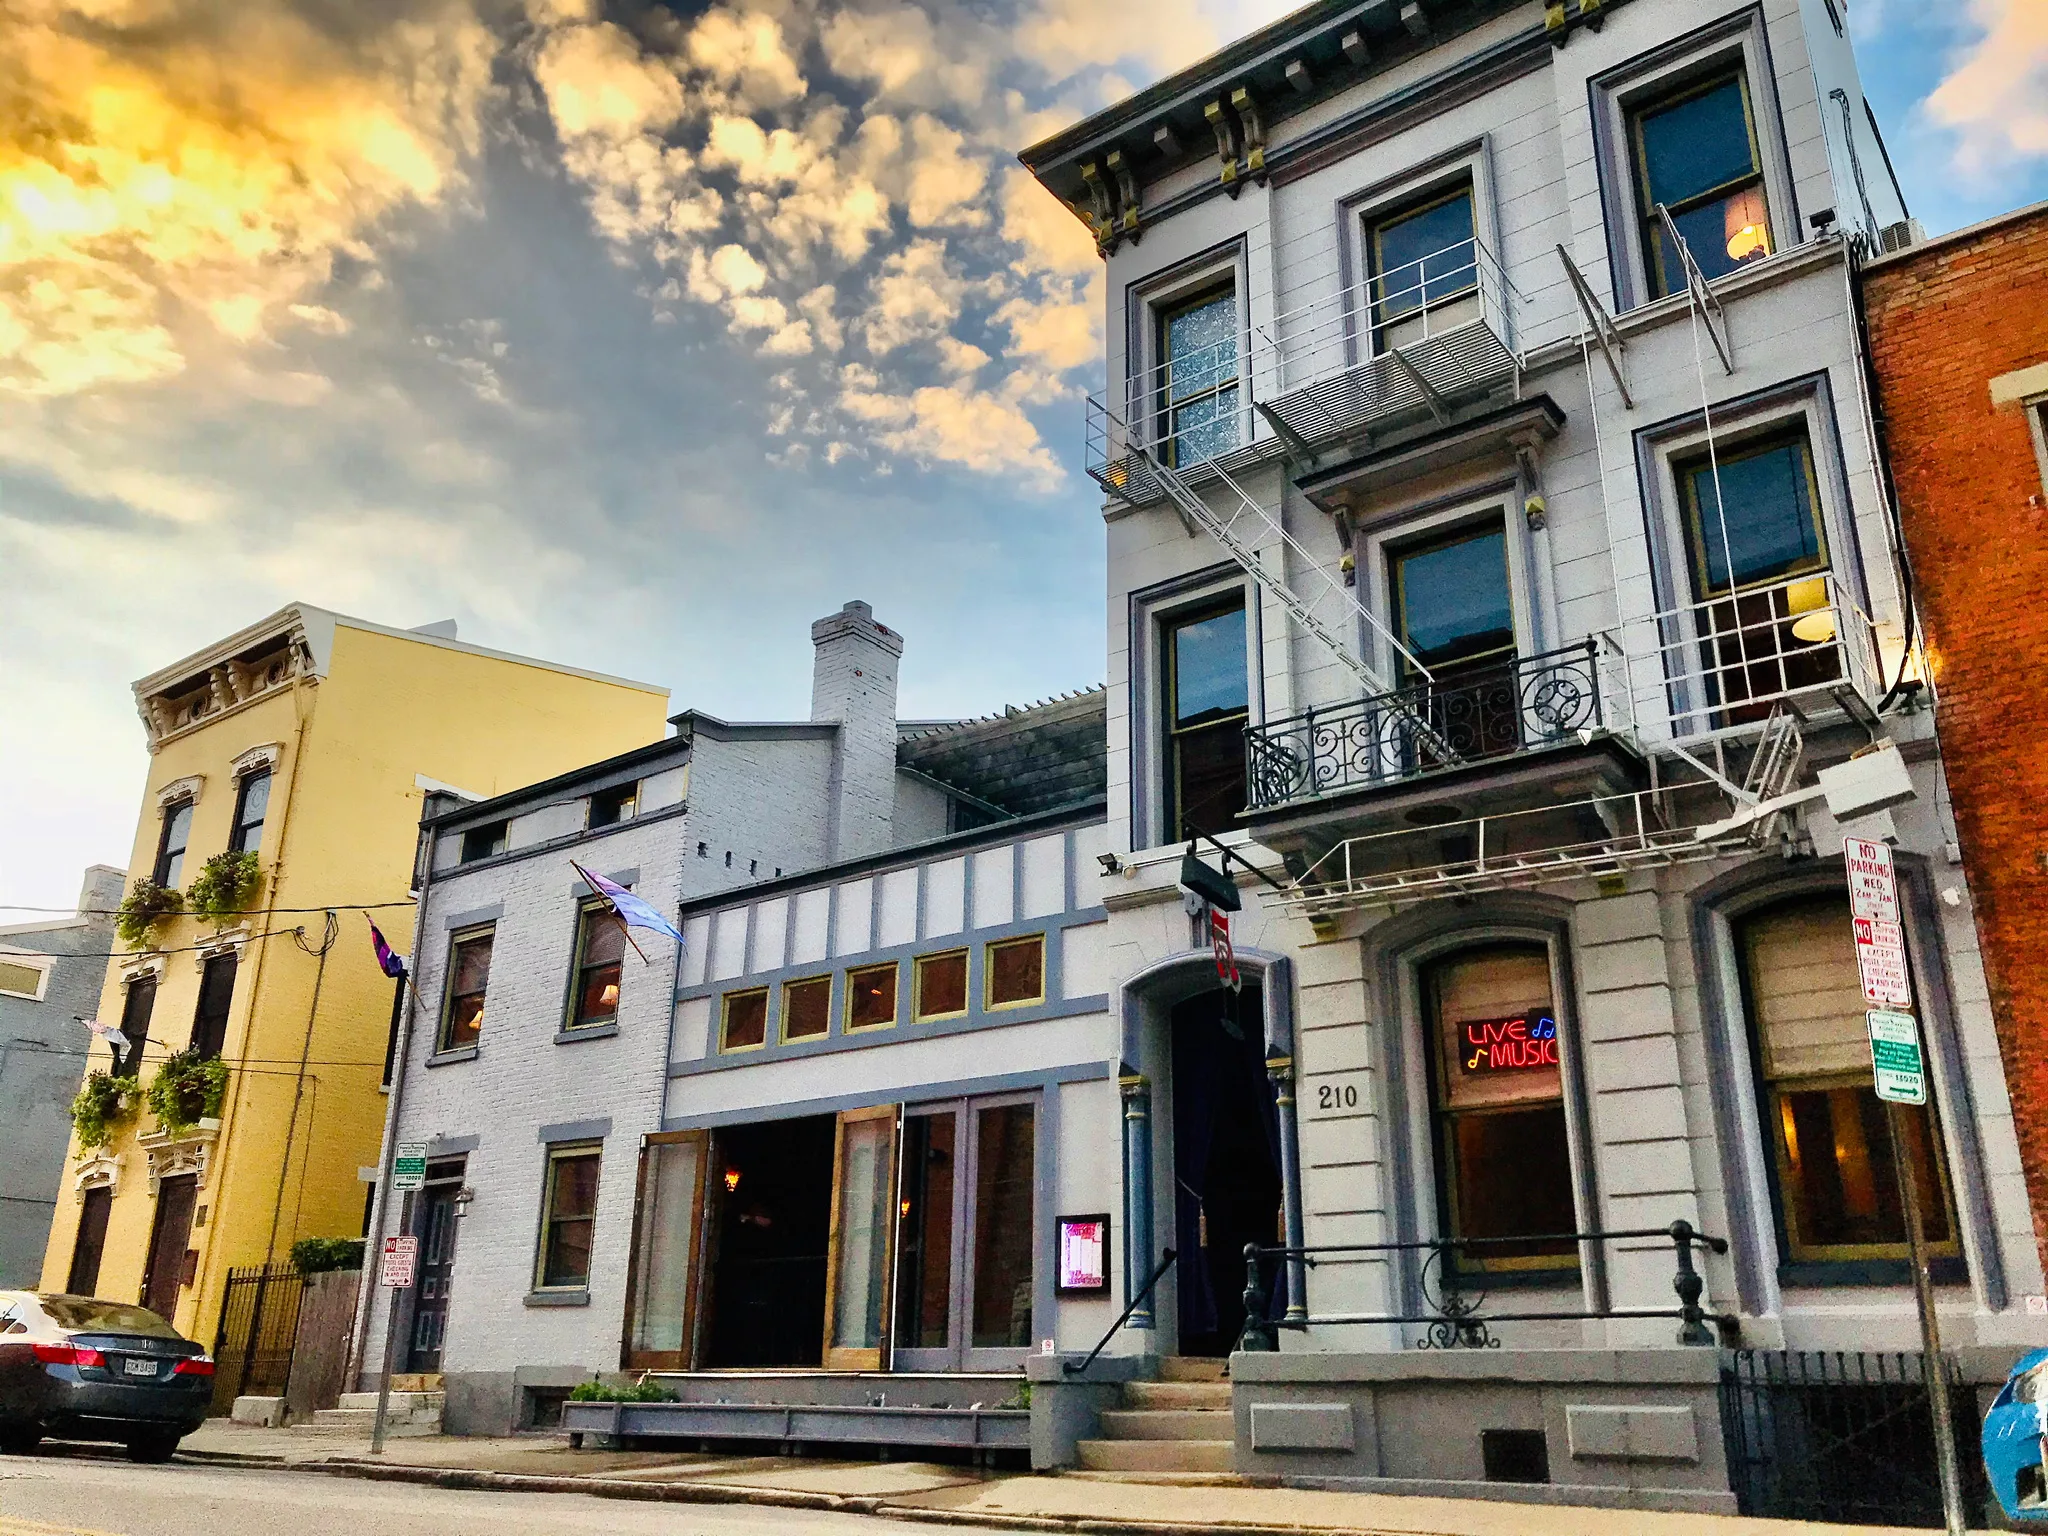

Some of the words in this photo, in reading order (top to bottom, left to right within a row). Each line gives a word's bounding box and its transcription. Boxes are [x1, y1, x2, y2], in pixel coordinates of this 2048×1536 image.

[1859, 844, 1876, 860] NO
[1851, 858, 1890, 878] PARKING
[1863, 877, 1885, 891] WED.
[1856, 922, 1871, 940] NO
[1867, 949, 1895, 958] EXCEPT
[1468, 1020, 1526, 1043] LIVE
[1490, 1038, 1558, 1068] MUSIC
[1319, 1085, 1357, 1109] 210
[386, 1240, 395, 1250] NO
